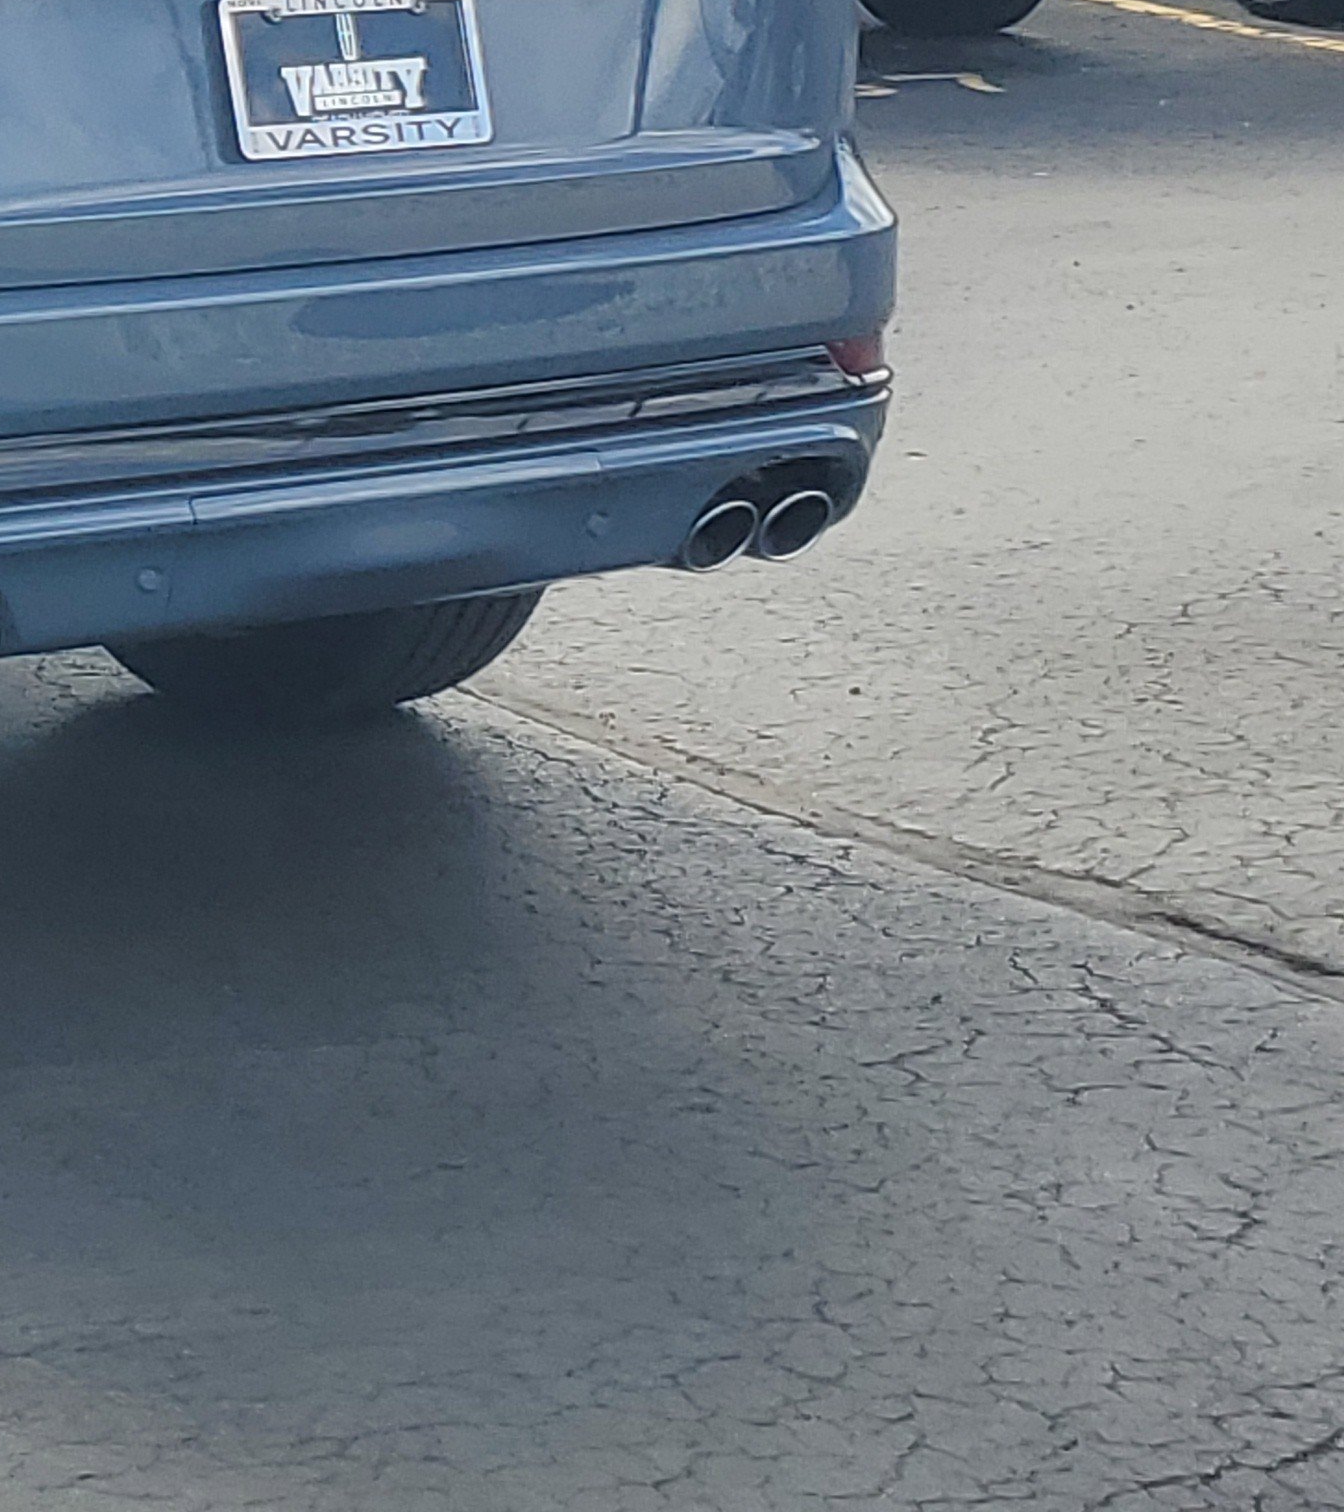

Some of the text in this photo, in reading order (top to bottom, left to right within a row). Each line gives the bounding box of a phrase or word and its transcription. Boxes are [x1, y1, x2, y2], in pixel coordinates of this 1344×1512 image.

[280, 56, 426, 117] VARSITY
[322, 93, 394, 108] LINCOLN
[265, 117, 462, 152] VARSITY
